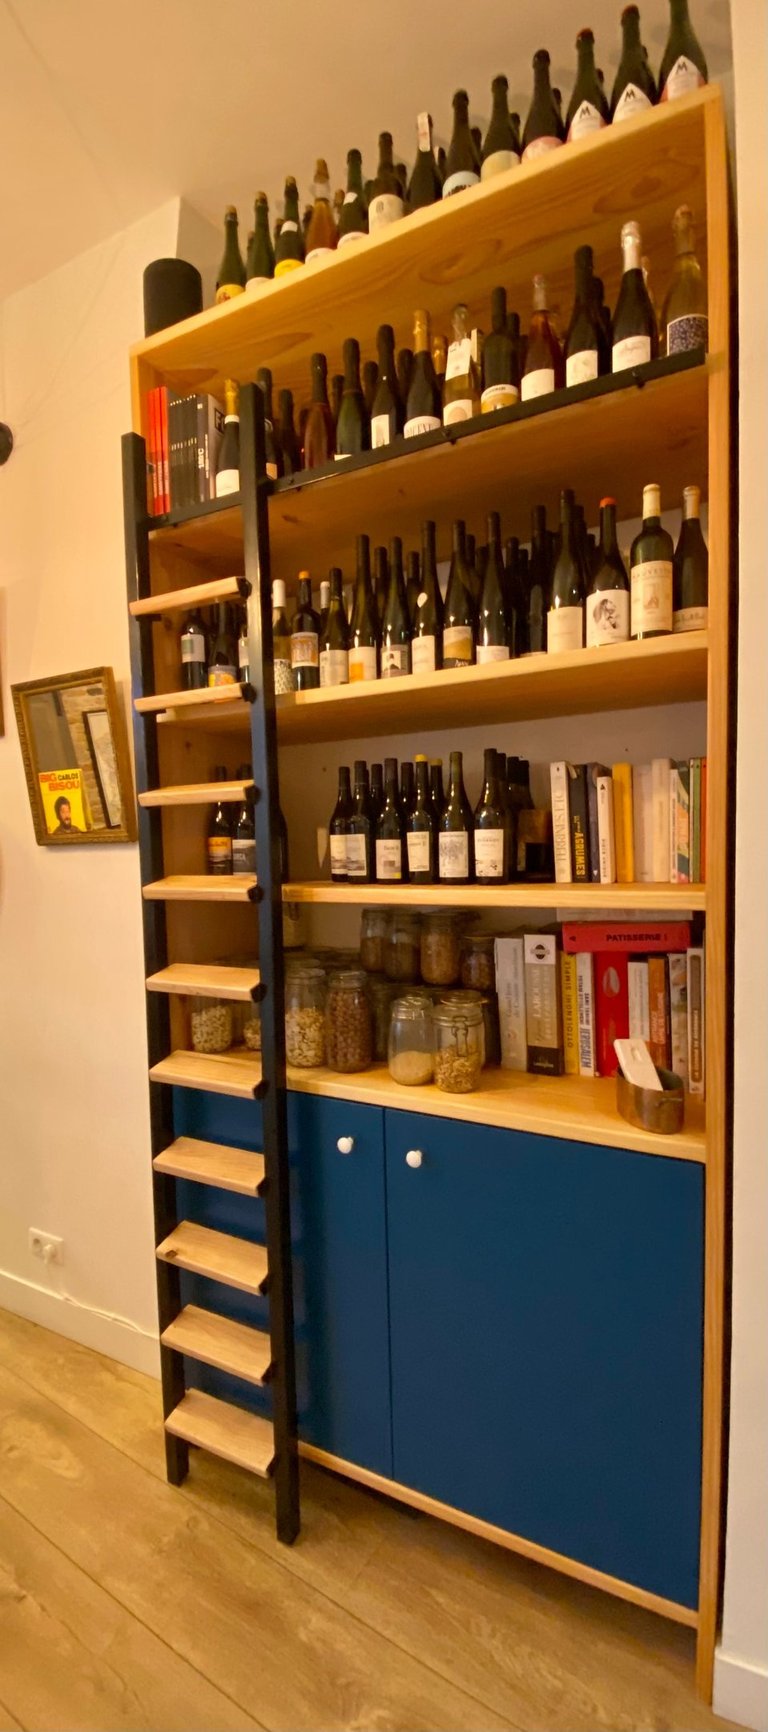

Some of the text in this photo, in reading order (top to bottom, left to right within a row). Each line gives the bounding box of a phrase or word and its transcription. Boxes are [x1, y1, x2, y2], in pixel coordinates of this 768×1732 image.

[40, 773, 79, 783] BIG CARLOS
[48, 780, 80, 791] BISOU
[574, 832, 586, 876] AGRUMES
[606, 933, 661, 942] PATISSERIE
[580, 1027, 592, 1068] JERUSALEM
